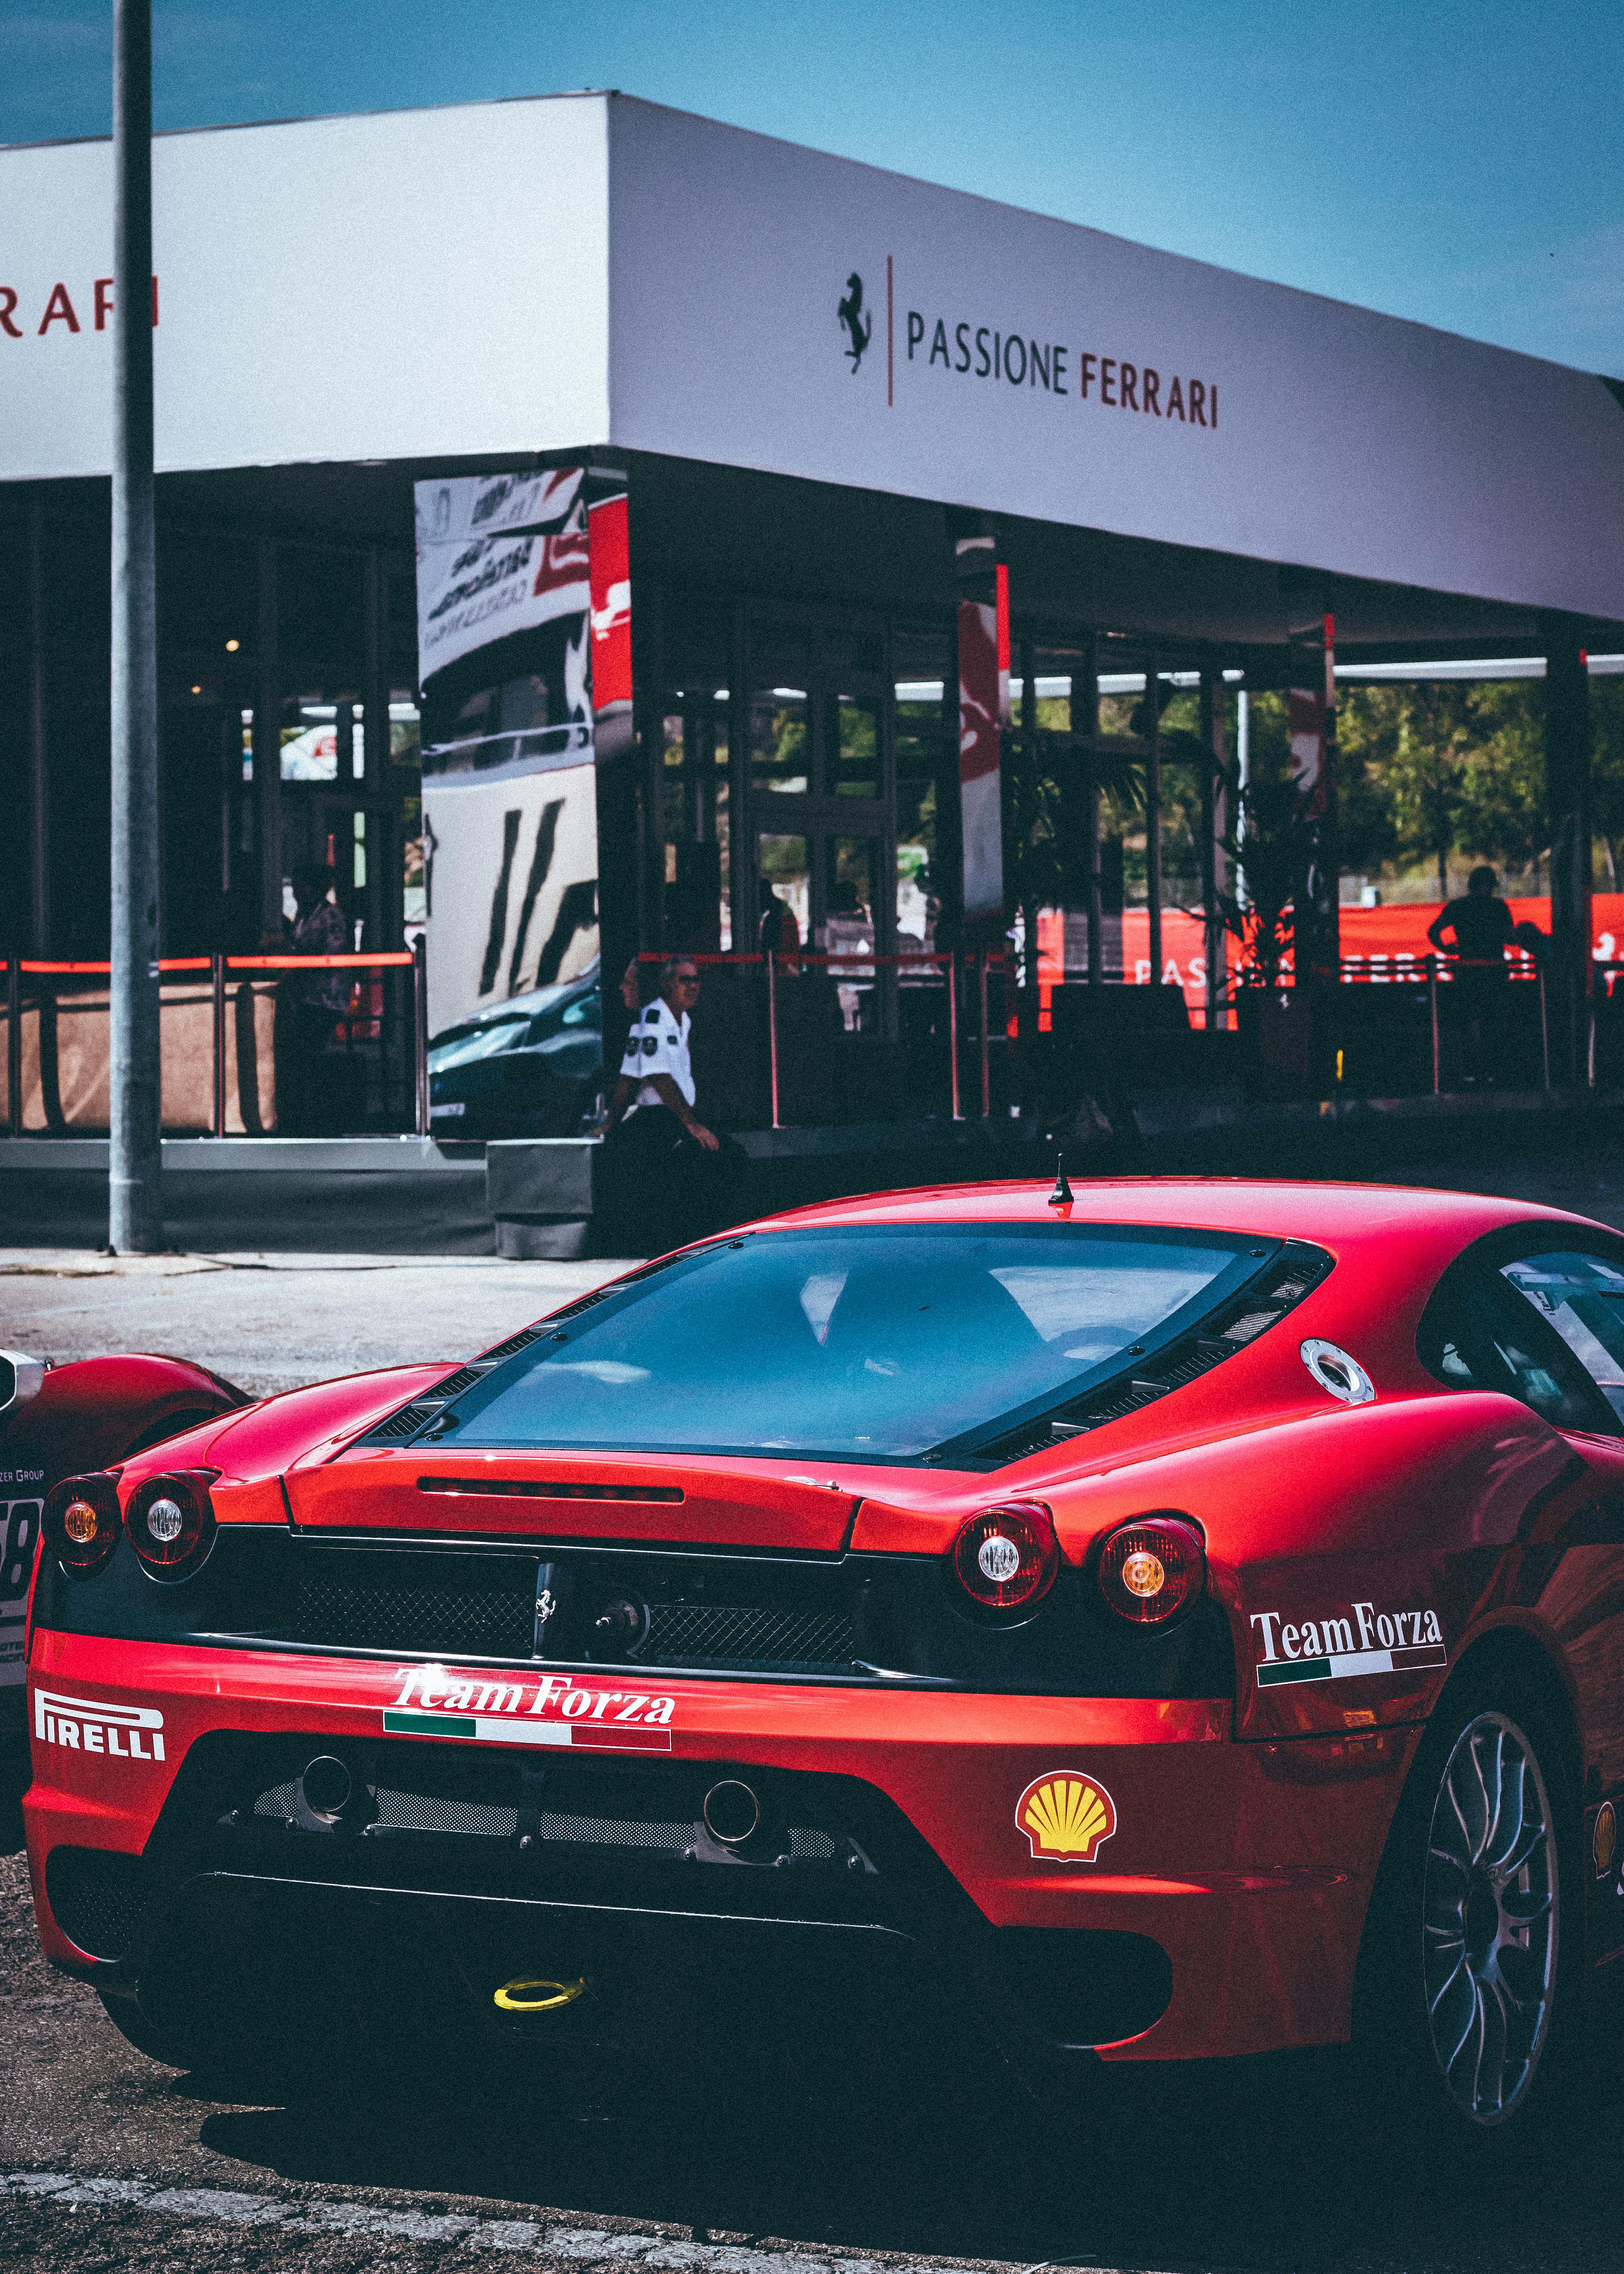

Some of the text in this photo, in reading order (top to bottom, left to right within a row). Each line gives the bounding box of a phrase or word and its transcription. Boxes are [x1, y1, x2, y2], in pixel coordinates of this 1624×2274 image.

[908, 311, 1218, 429] PASSIONE FERRARI
[1250, 1602, 1443, 1661] Team Forza
[34, 1688, 165, 1761] PIRELLI
[389, 1667, 676, 1724] Team Forza
